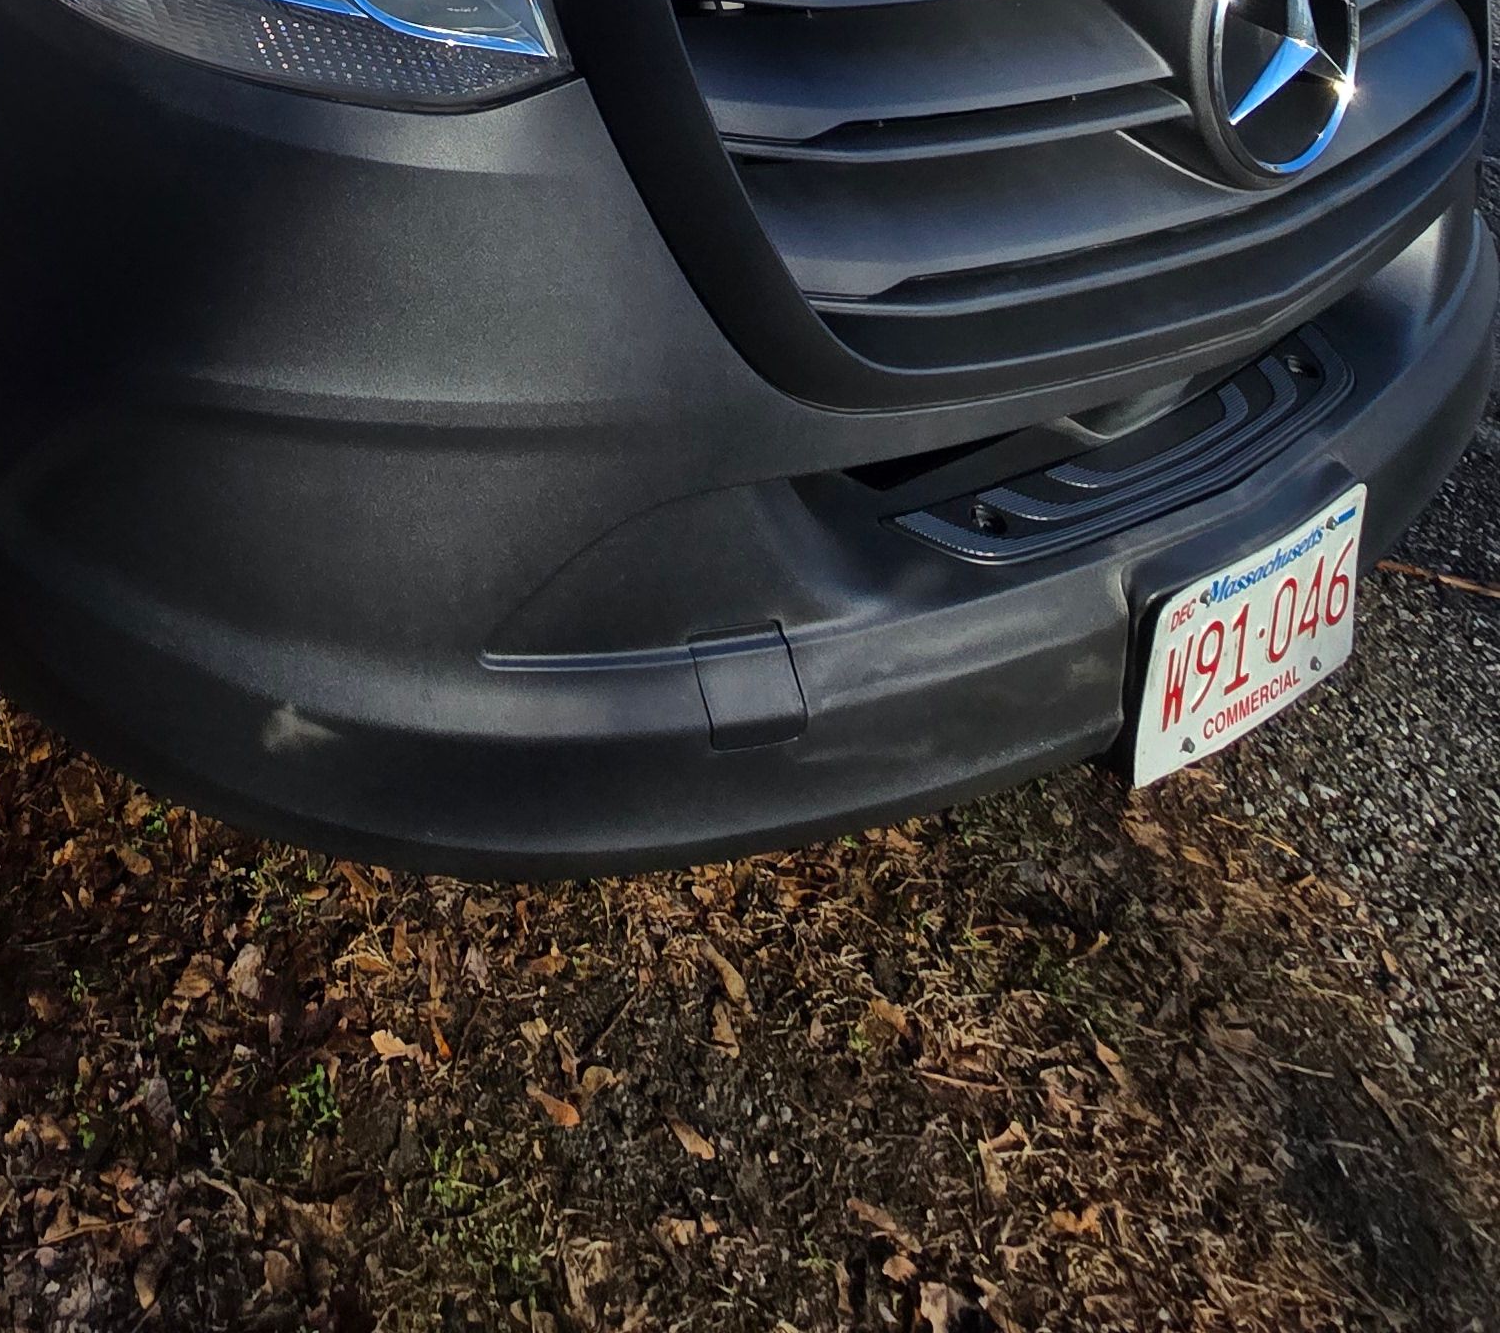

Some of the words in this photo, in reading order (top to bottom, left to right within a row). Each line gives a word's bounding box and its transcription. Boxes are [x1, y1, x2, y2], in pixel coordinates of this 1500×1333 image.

[1209, 524, 1325, 604] Massachusetts
[1170, 598, 1197, 633] DEC
[1203, 666, 1301, 740] COMMERCIAL
